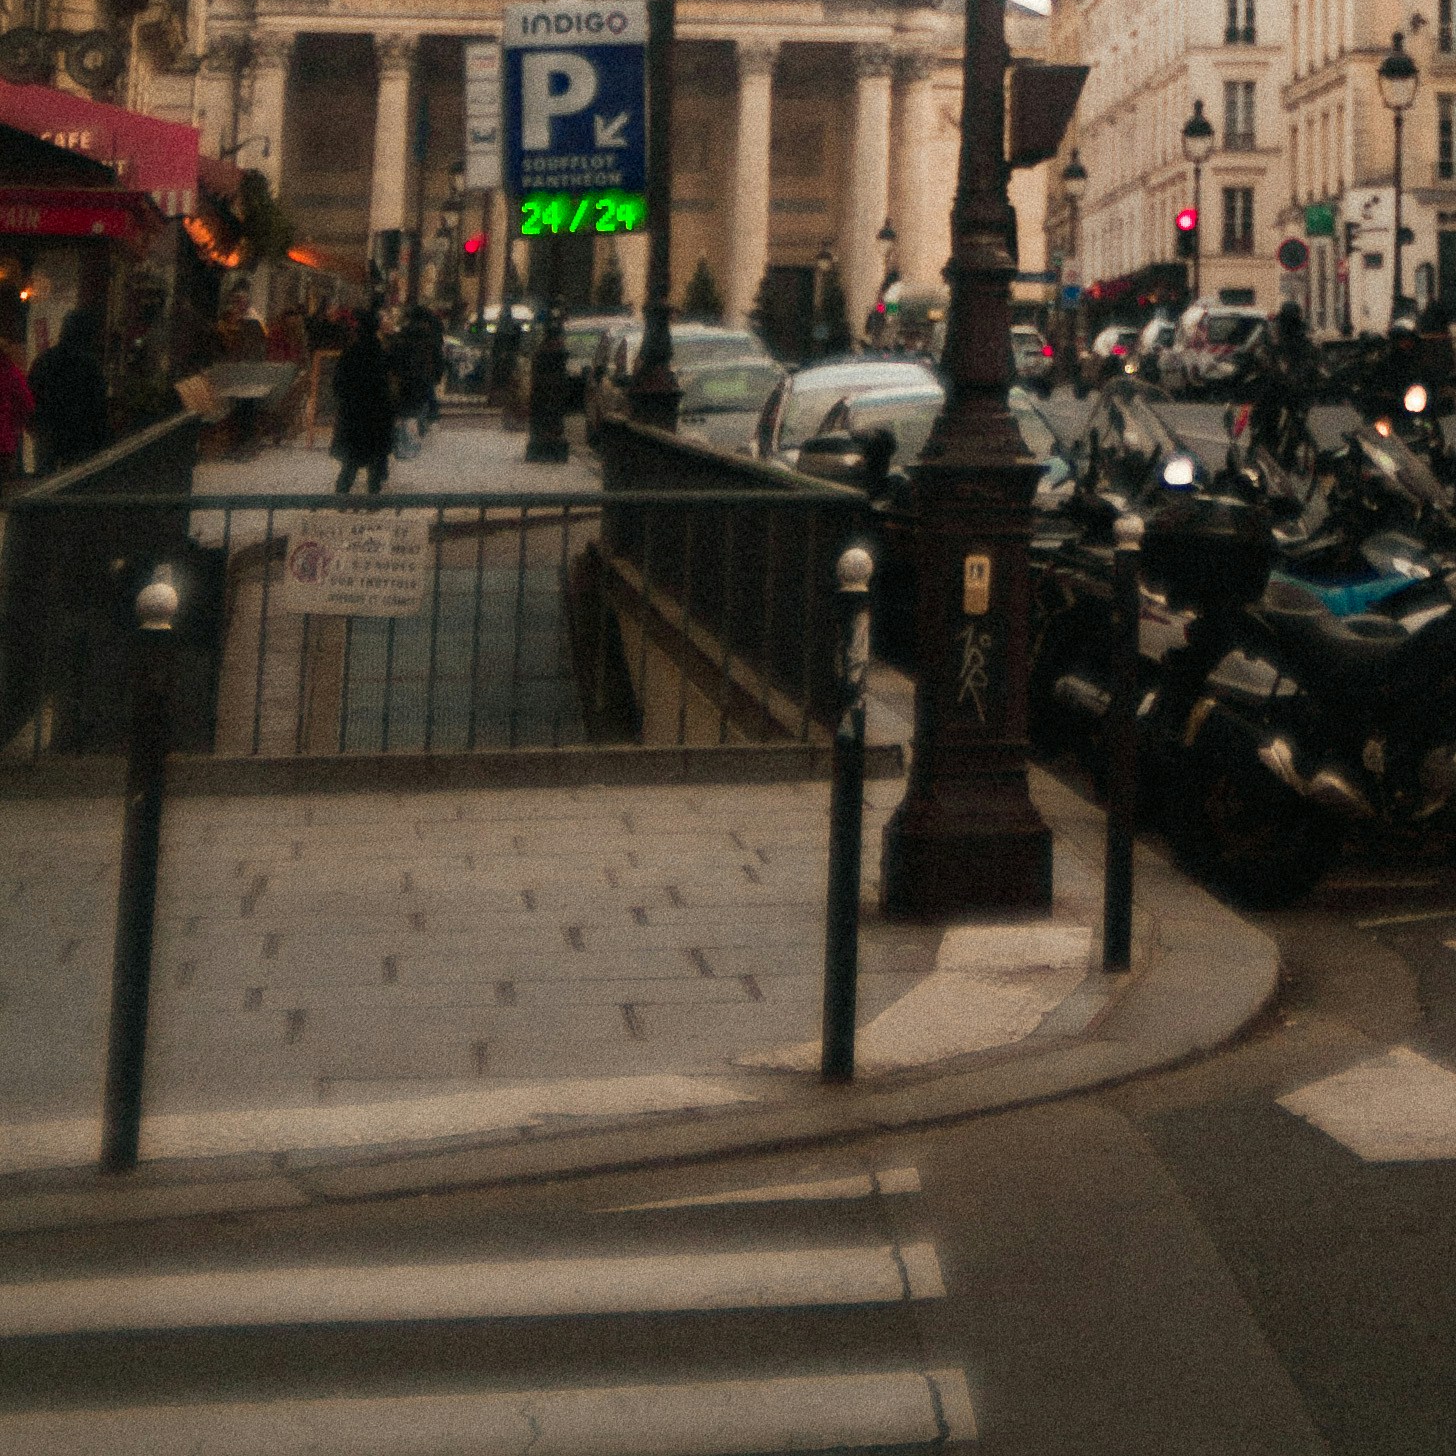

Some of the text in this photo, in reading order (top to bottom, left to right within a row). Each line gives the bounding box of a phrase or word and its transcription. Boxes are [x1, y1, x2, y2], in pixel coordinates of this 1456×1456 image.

[522, 11, 628, 35] INDIGO
[521, 52, 597, 150] P
[520, 199, 636, 235] 24/24
